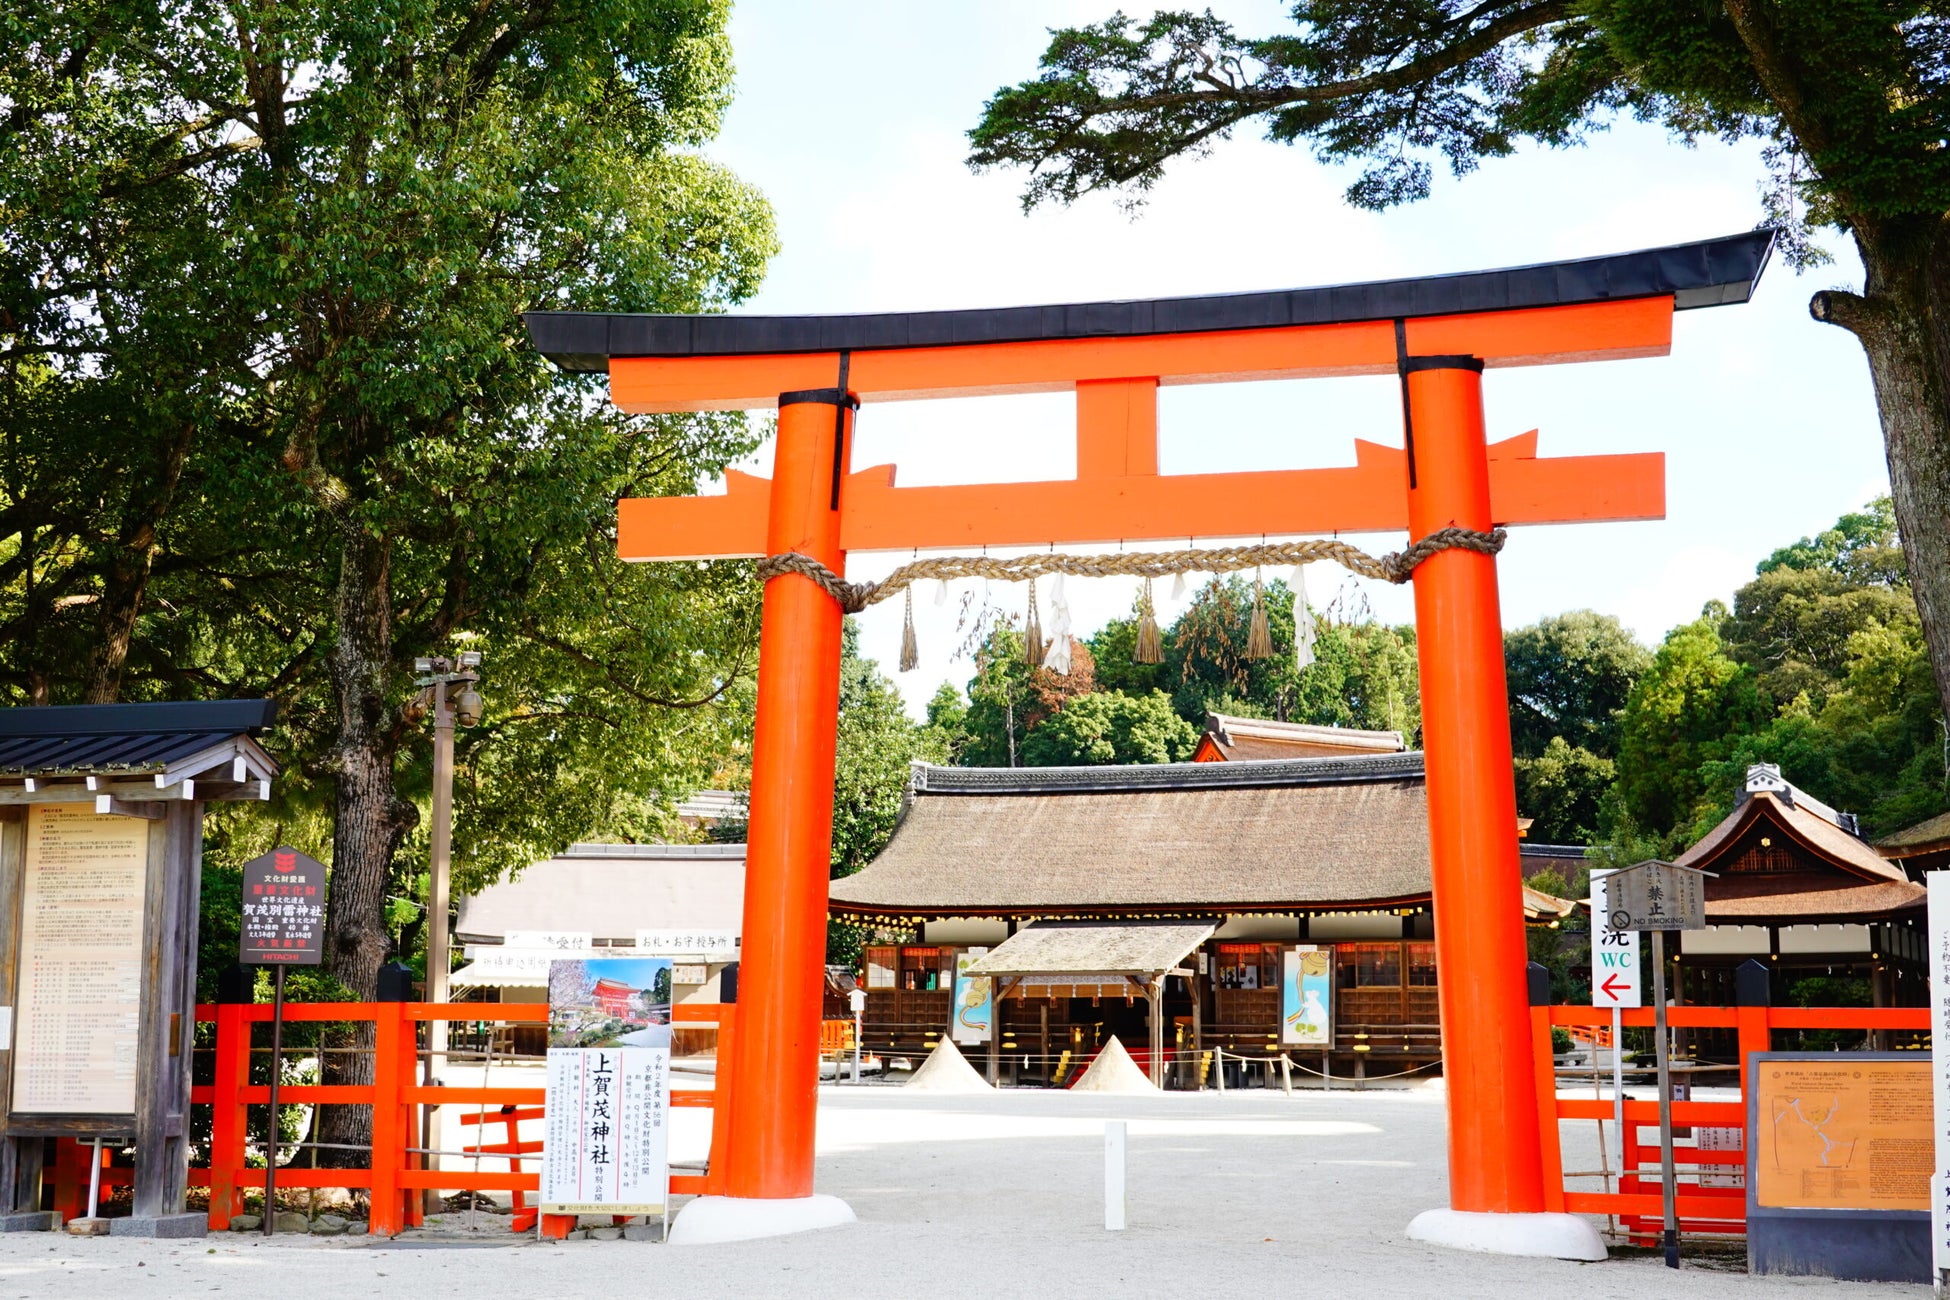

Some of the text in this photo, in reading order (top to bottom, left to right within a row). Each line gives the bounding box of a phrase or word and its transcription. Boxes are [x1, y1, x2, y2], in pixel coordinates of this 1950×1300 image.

[264, 875, 306, 884] 文化財愛護
[253, 884, 317, 896] 重要文化財
[261, 896, 305, 905] 世界文化遺産
[1647, 885, 1665, 916] 禁止
[243, 903, 323, 917] 賀茂別雷神社
[1648, 917, 1685, 925] SMOKING
[257, 939, 307, 948] 火気厳禁
[262, 953, 300, 961] HITACHI
[1600, 952, 1631, 968] WC
[654, 1054, 662, 1098] 令和2年度
[590, 1052, 613, 1202] 上賀茂神社 特別公開
